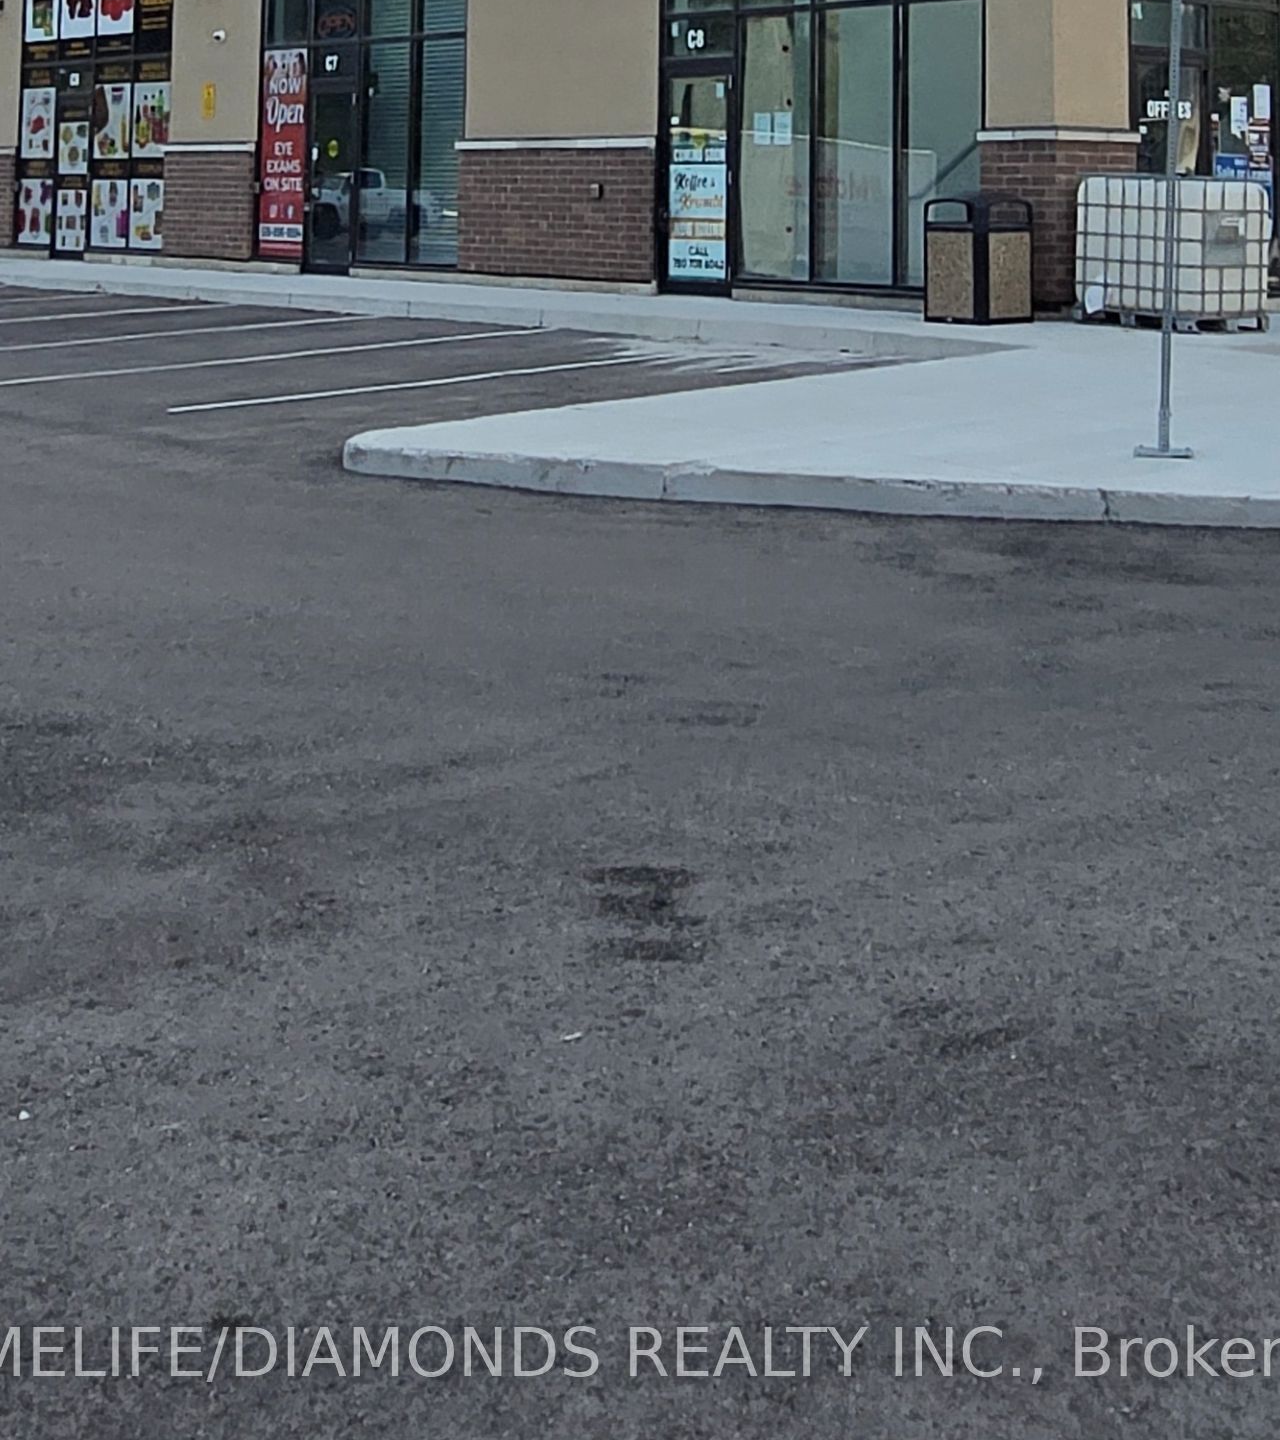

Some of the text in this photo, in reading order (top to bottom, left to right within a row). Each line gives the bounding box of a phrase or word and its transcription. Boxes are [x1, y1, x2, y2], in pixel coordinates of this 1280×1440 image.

[687, 29, 705, 49] C8
[270, 78, 302, 95] NOW
[266, 96, 304, 133] Open
[1147, 100, 1192, 120] OFFES
[274, 141, 293, 156] EYE
[266, 159, 301, 174] EXAMS
[264, 177, 303, 192] ON SITE
